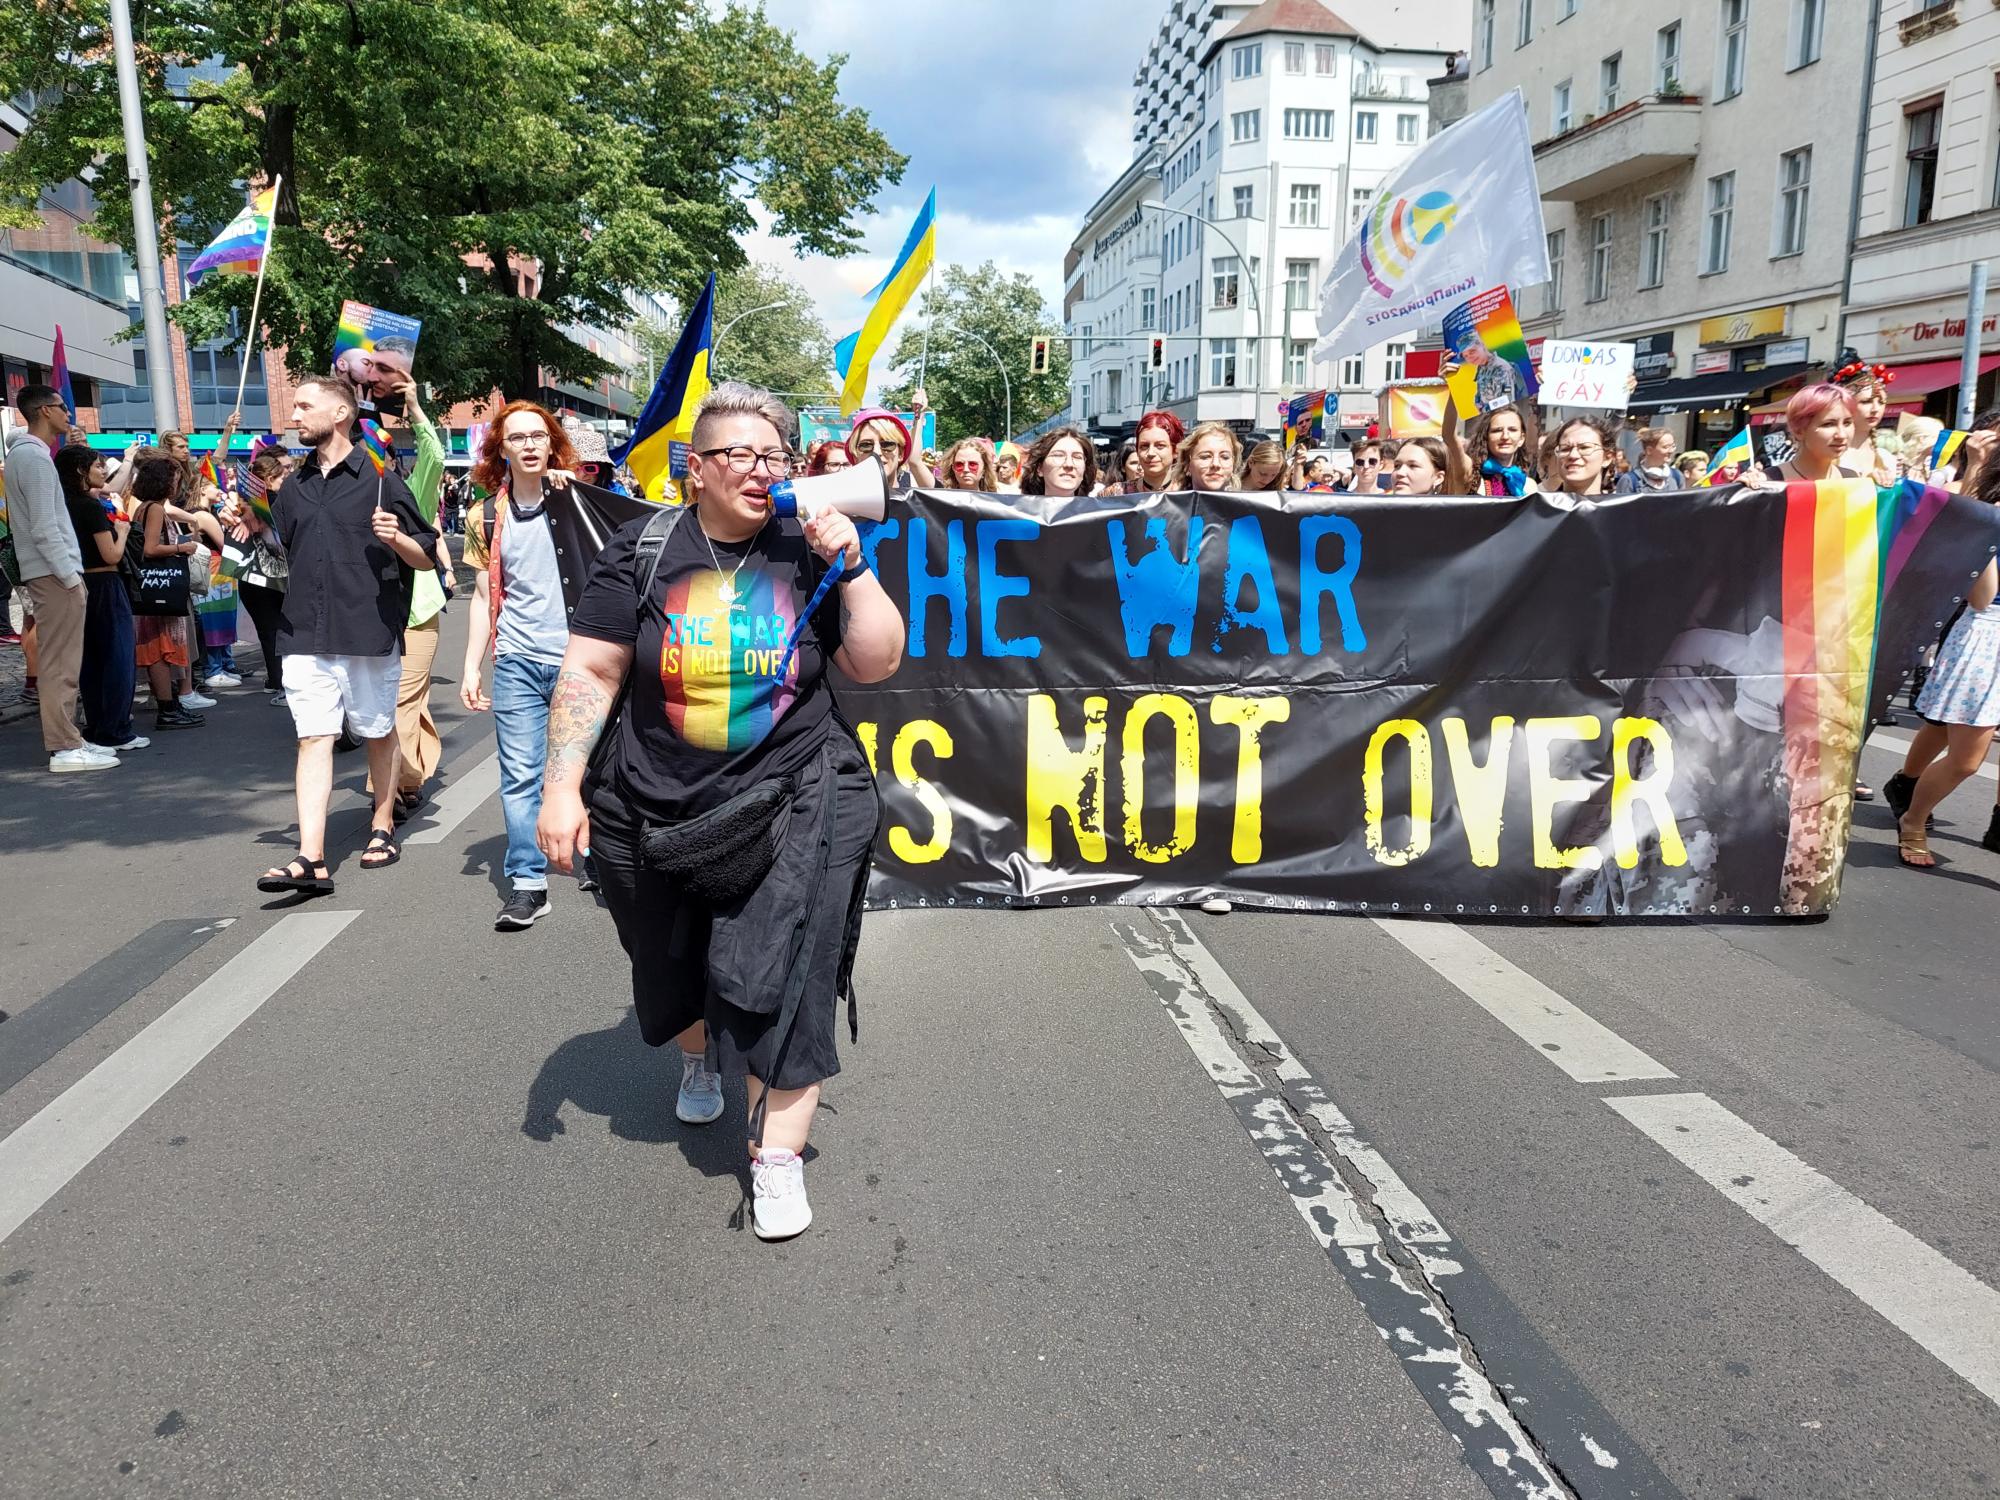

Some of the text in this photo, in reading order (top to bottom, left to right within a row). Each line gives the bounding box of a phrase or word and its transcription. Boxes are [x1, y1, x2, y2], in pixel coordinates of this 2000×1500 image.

[1913, 322, 1939, 341] Die
[1552, 346, 1617, 366] DONBAS
[1573, 368, 1586, 381] IS
[1556, 381, 1605, 402] GAY
[1106, 514, 1367, 658] WAR
[666, 613, 788, 646] THE WAR
[662, 648, 680, 674] IS
[691, 648, 732, 675] NOT
[857, 693, 1689, 870] S NOT OVER
